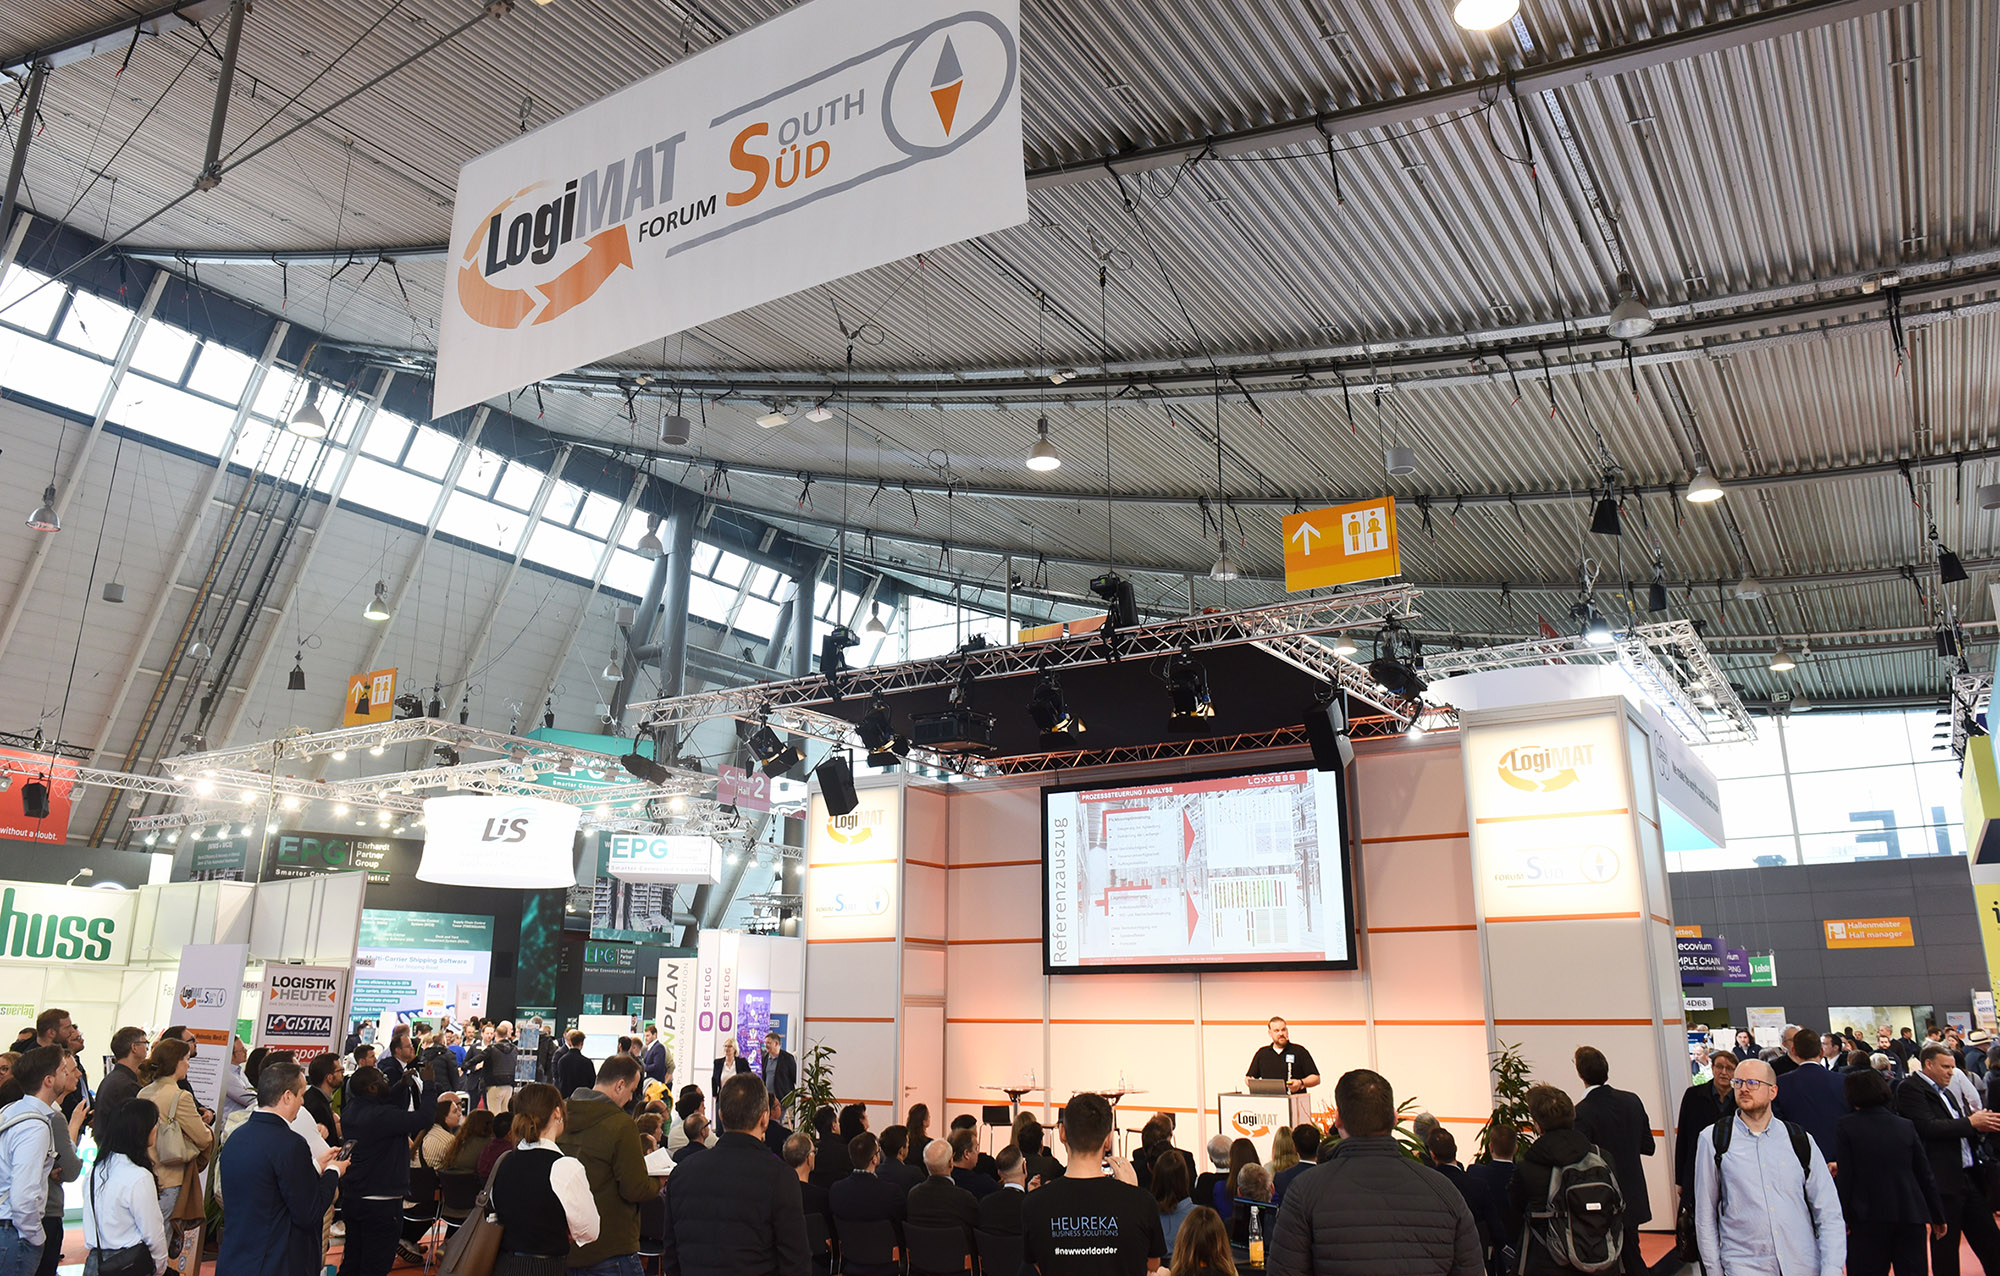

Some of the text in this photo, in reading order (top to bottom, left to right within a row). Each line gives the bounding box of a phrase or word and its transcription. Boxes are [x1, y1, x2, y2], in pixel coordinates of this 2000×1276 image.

[485, 132, 686, 277] LogiMAT
[639, 194, 716, 243] FORUM
[1510, 744, 1594, 773] LogiMAT
[1248, 774, 1296, 784] LOXXESS
[737, 785, 751, 796] Hall
[754, 776, 765, 799] 2
[1082, 789, 1142, 801] PROZESSSTEUERUNG
[1147, 787, 1174, 795] ANALYSE
[277, 836, 391, 865] EPG Ehrhardt
[356, 851, 385, 859] Partner
[612, 838, 668, 859] EPG
[355, 859, 380, 869] Group
[275, 869, 307, 877] Smarter
[1053, 817, 1068, 963] Referenzauszug
[0, 887, 115, 961] huss
[1847, 920, 1901, 930] Hallenmeister
[1849, 930, 1904, 941] Hall manager
[1678, 941, 1712, 950] ecovium
[409, 957, 438, 965] Shipping
[1699, 956, 1721, 965] CHAIN
[272, 976, 337, 990] LOGISTIK
[680, 963, 689, 1013] EXECUTION
[703, 967, 712, 1008] SETLOG
[723, 967, 731, 1008] SETLOG
[280, 989, 327, 1001] HEUTE
[267, 1015, 331, 1031] LOGISTRA
[1238, 1113, 1278, 1126] LogiMAT
[1051, 1216, 1118, 1231] HEUREKA
[1082, 1229, 1119, 1237] SOLUTIONS
[1054, 1246, 1118, 1255] #newworldorder
